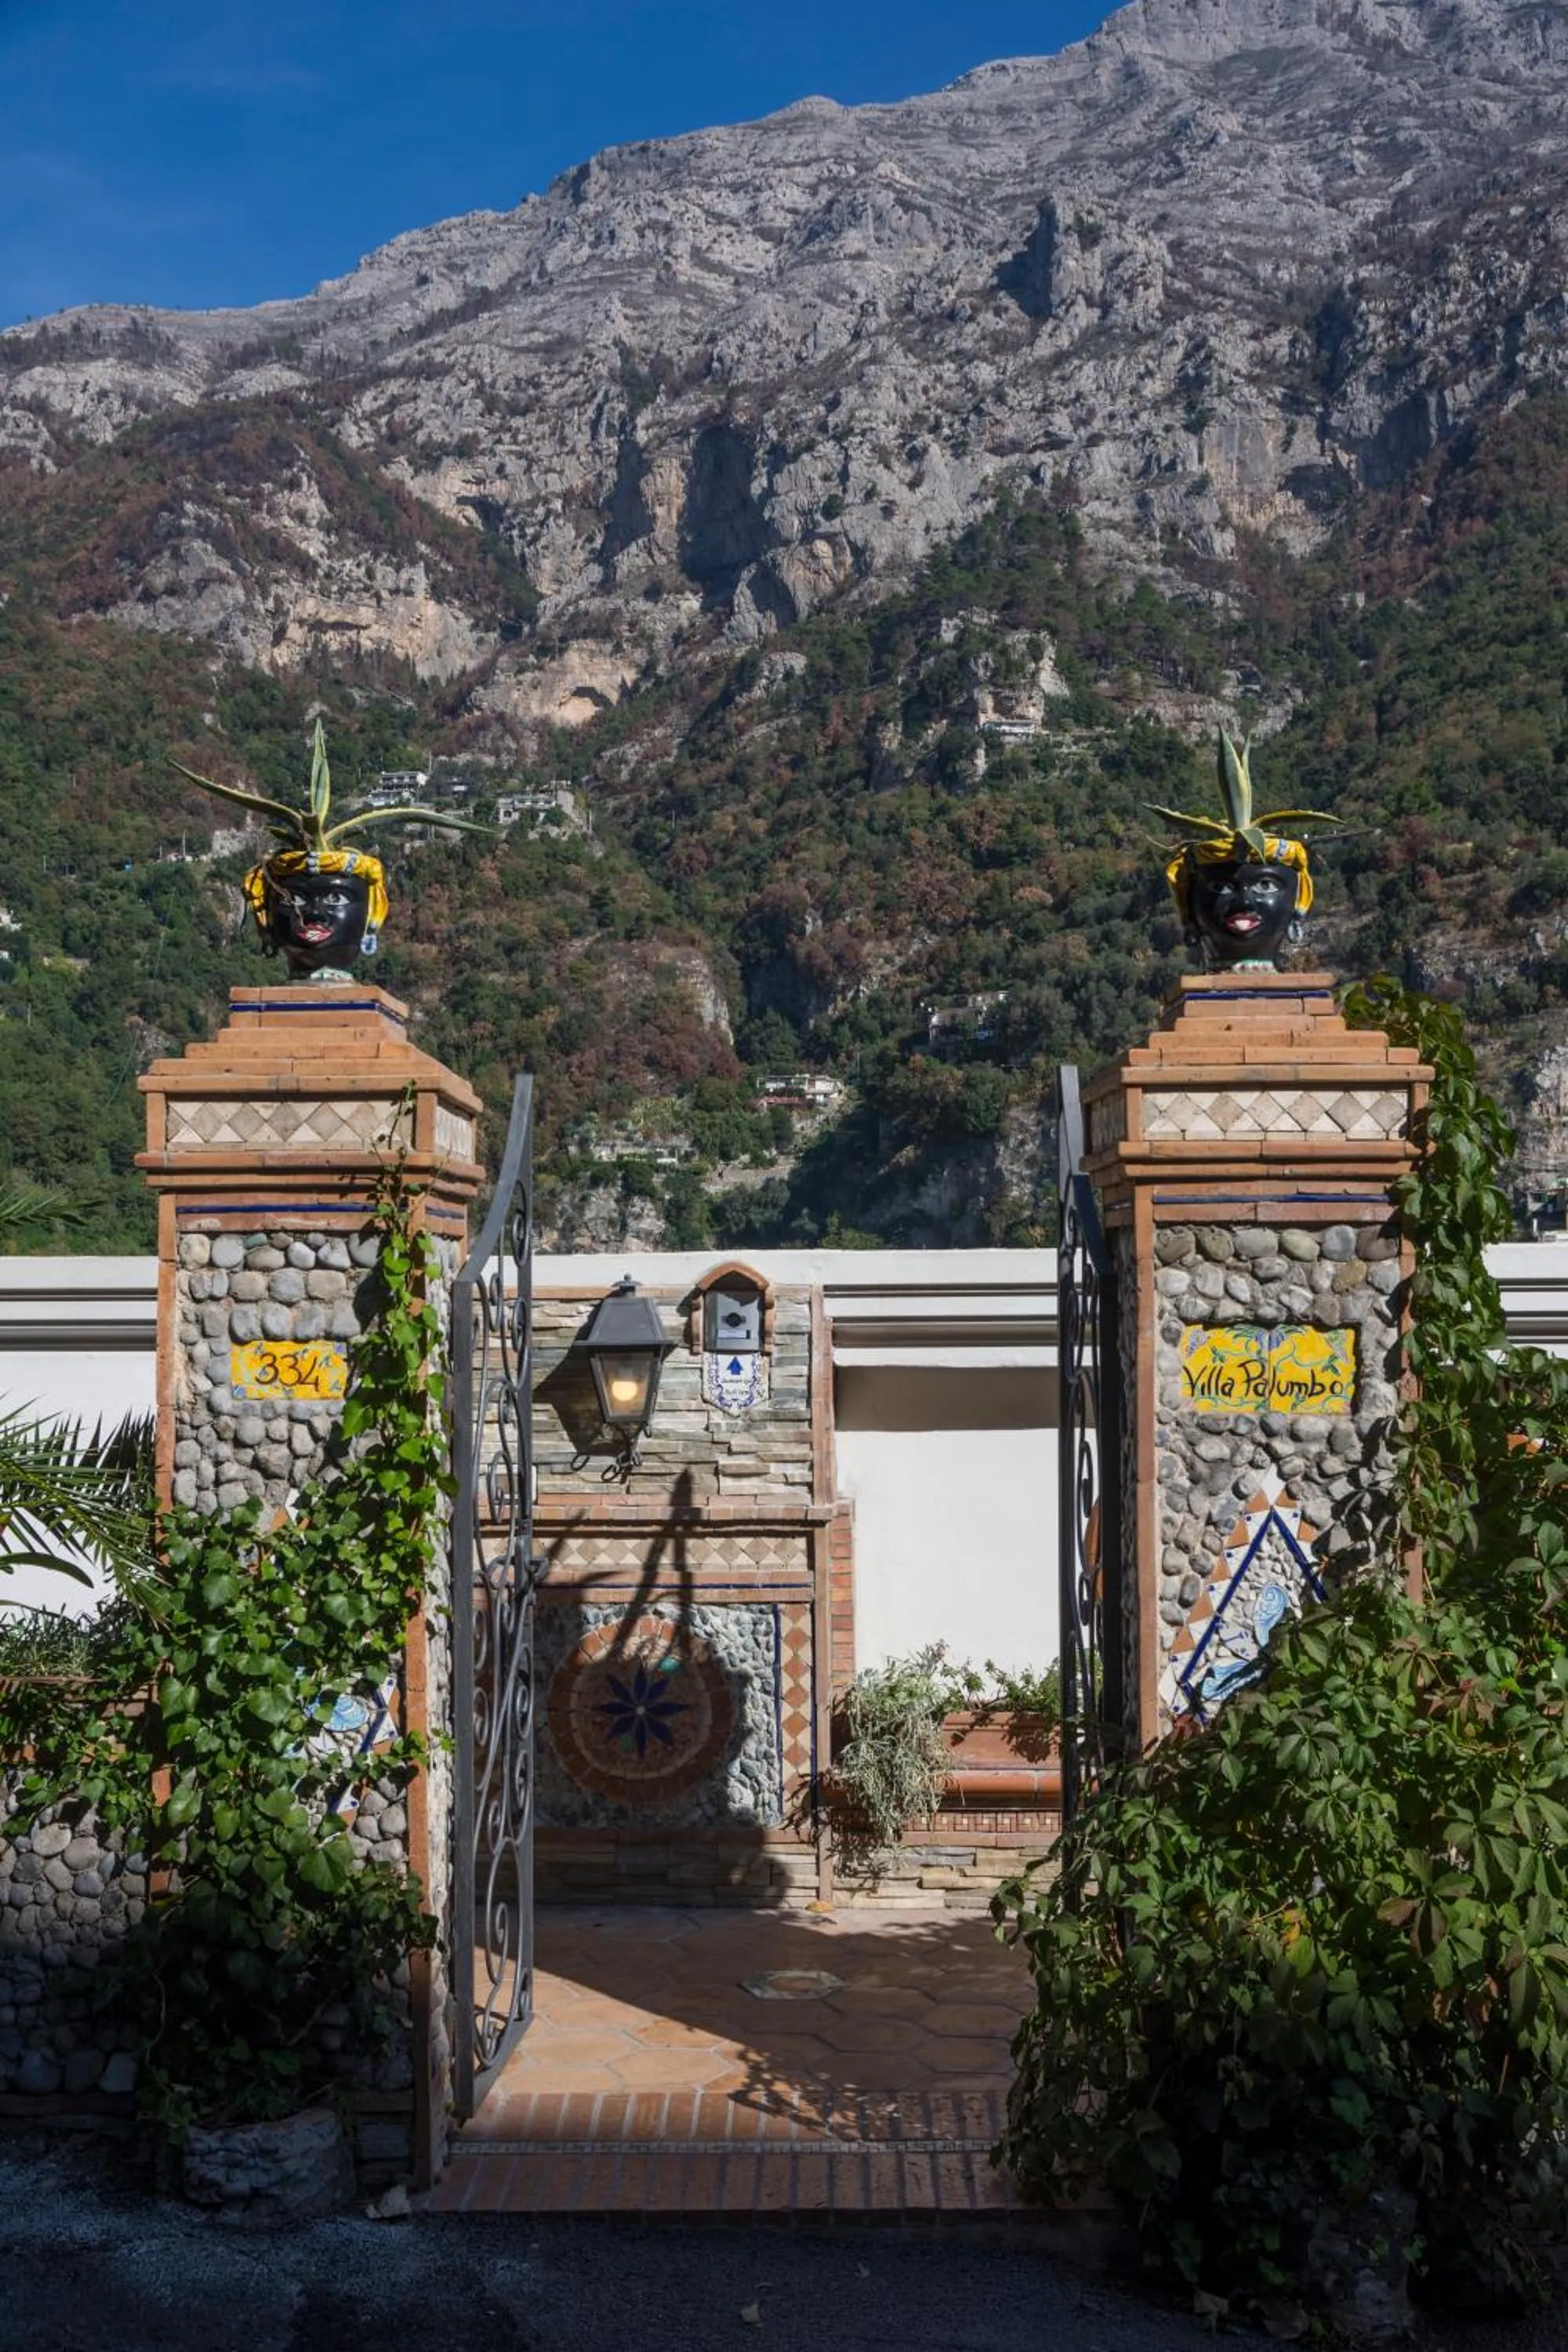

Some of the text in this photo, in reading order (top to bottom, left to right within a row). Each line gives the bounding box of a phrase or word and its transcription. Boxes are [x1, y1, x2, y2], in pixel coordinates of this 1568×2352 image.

[255, 1352, 320, 1392] 334
[1182, 1359, 1343, 1398] Villa Palumbo
